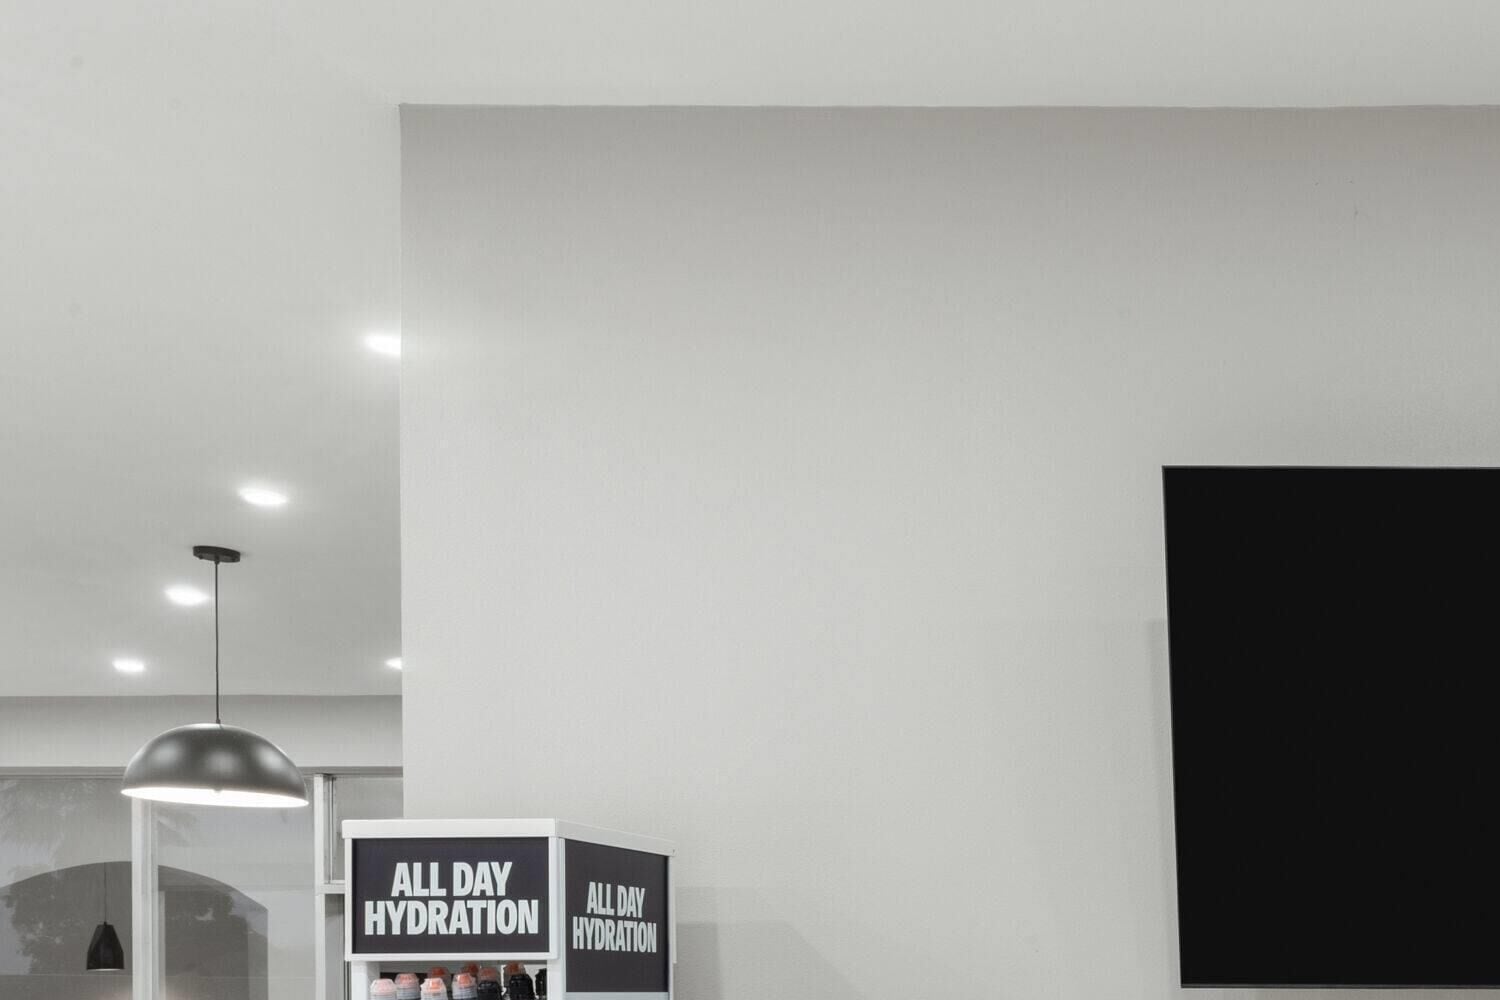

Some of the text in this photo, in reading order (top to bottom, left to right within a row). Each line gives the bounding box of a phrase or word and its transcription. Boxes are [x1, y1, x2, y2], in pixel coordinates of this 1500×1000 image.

[391, 861, 513, 897] ALL DAY
[364, 900, 539, 935] HYDRATION
[586, 881, 645, 918] ALL DAY
[572, 916, 657, 953] HYDRATION
